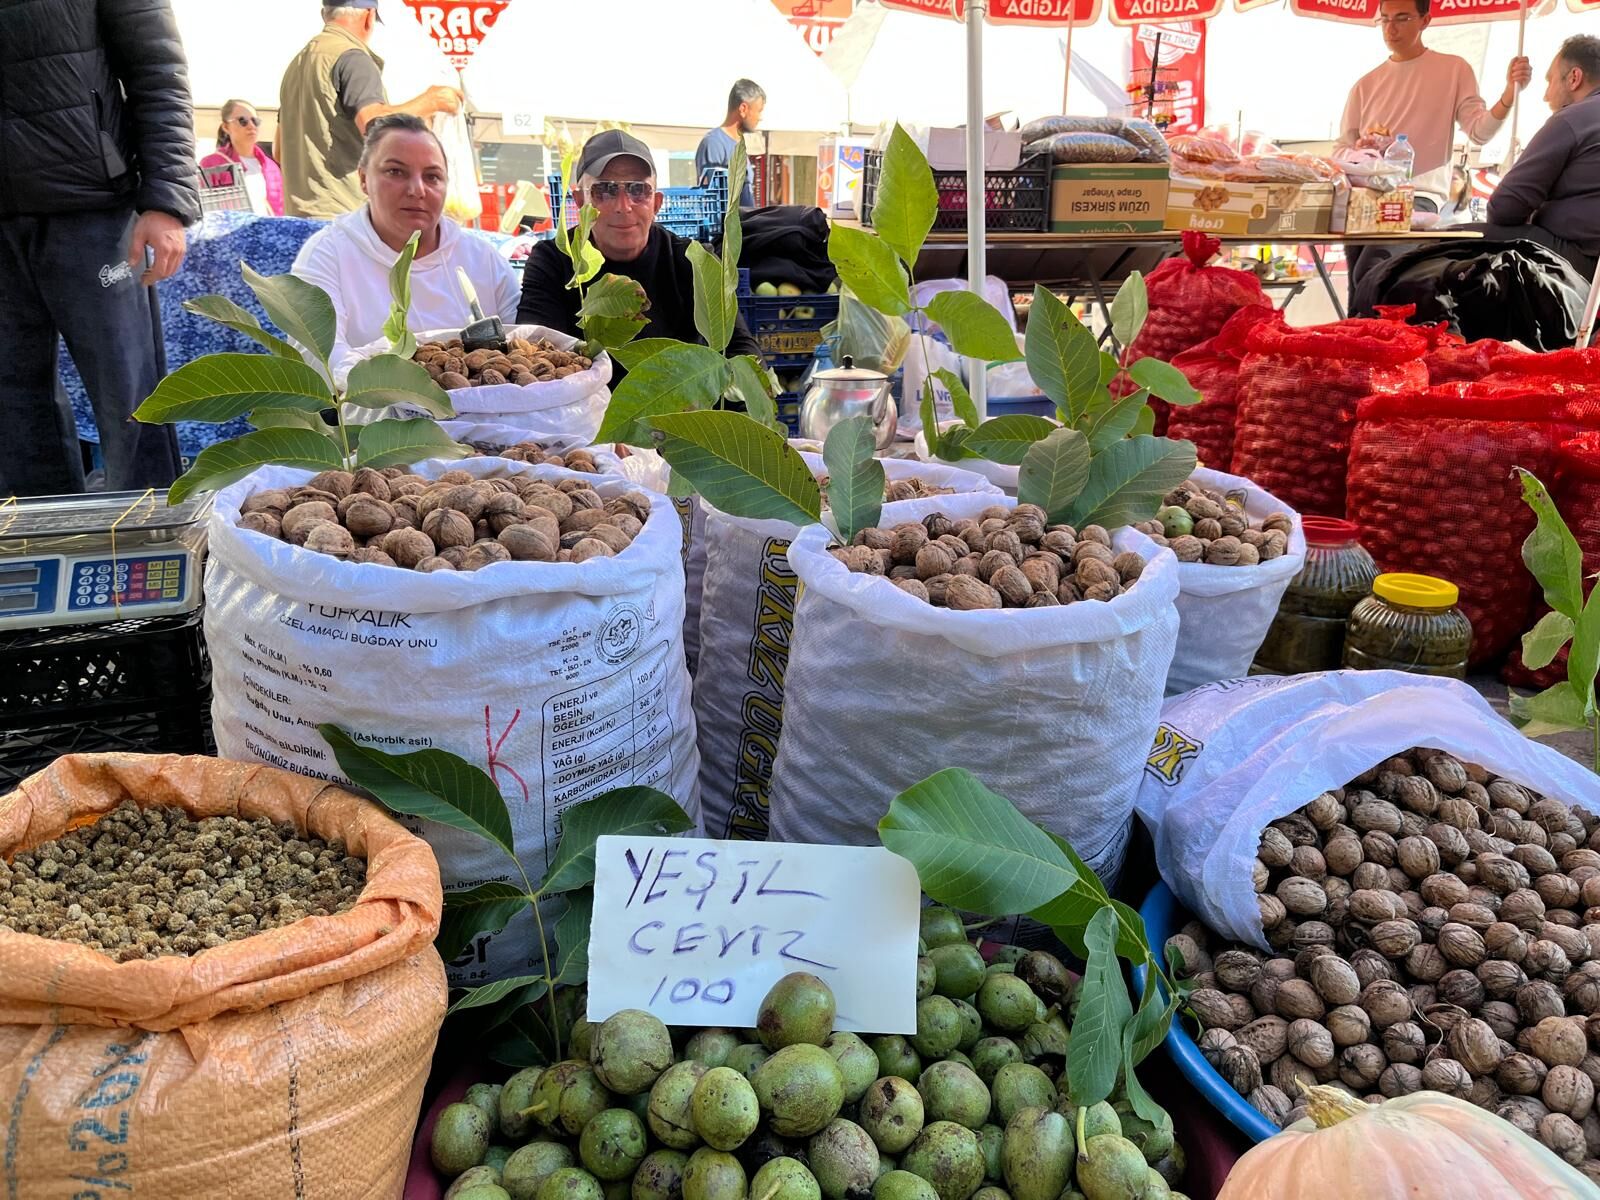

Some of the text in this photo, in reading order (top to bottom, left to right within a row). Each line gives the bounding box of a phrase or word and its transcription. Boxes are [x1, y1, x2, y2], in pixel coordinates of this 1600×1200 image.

[513, 113, 531, 127] 62
[1082, 188, 1143, 199] Grape Vinegar
[1071, 200, 1150, 215] ÜZÜM SİRKESİ
[306, 624, 349, 641] AMAÇLI
[351, 633, 403, 648] BUĞDAY
[408, 638, 438, 648] UNU
[314, 666, 332, 678] 0,60
[553, 694, 588, 712] ENERJİ
[553, 708, 583, 724] BESİN
[353, 731, 405, 745] (Askorbik
[408, 737, 433, 748] asit)
[552, 733, 585, 751] ENERJİ
[485, 705, 528, 802] K
[553, 755, 572, 769] YAĞ
[574, 752, 586, 765] (g)
[289, 762, 329, 780] BUĞDAY
[559, 764, 597, 784] DOYMUŞ
[598, 755, 614, 768] YAĞ
[649, 976, 736, 1006] 100
